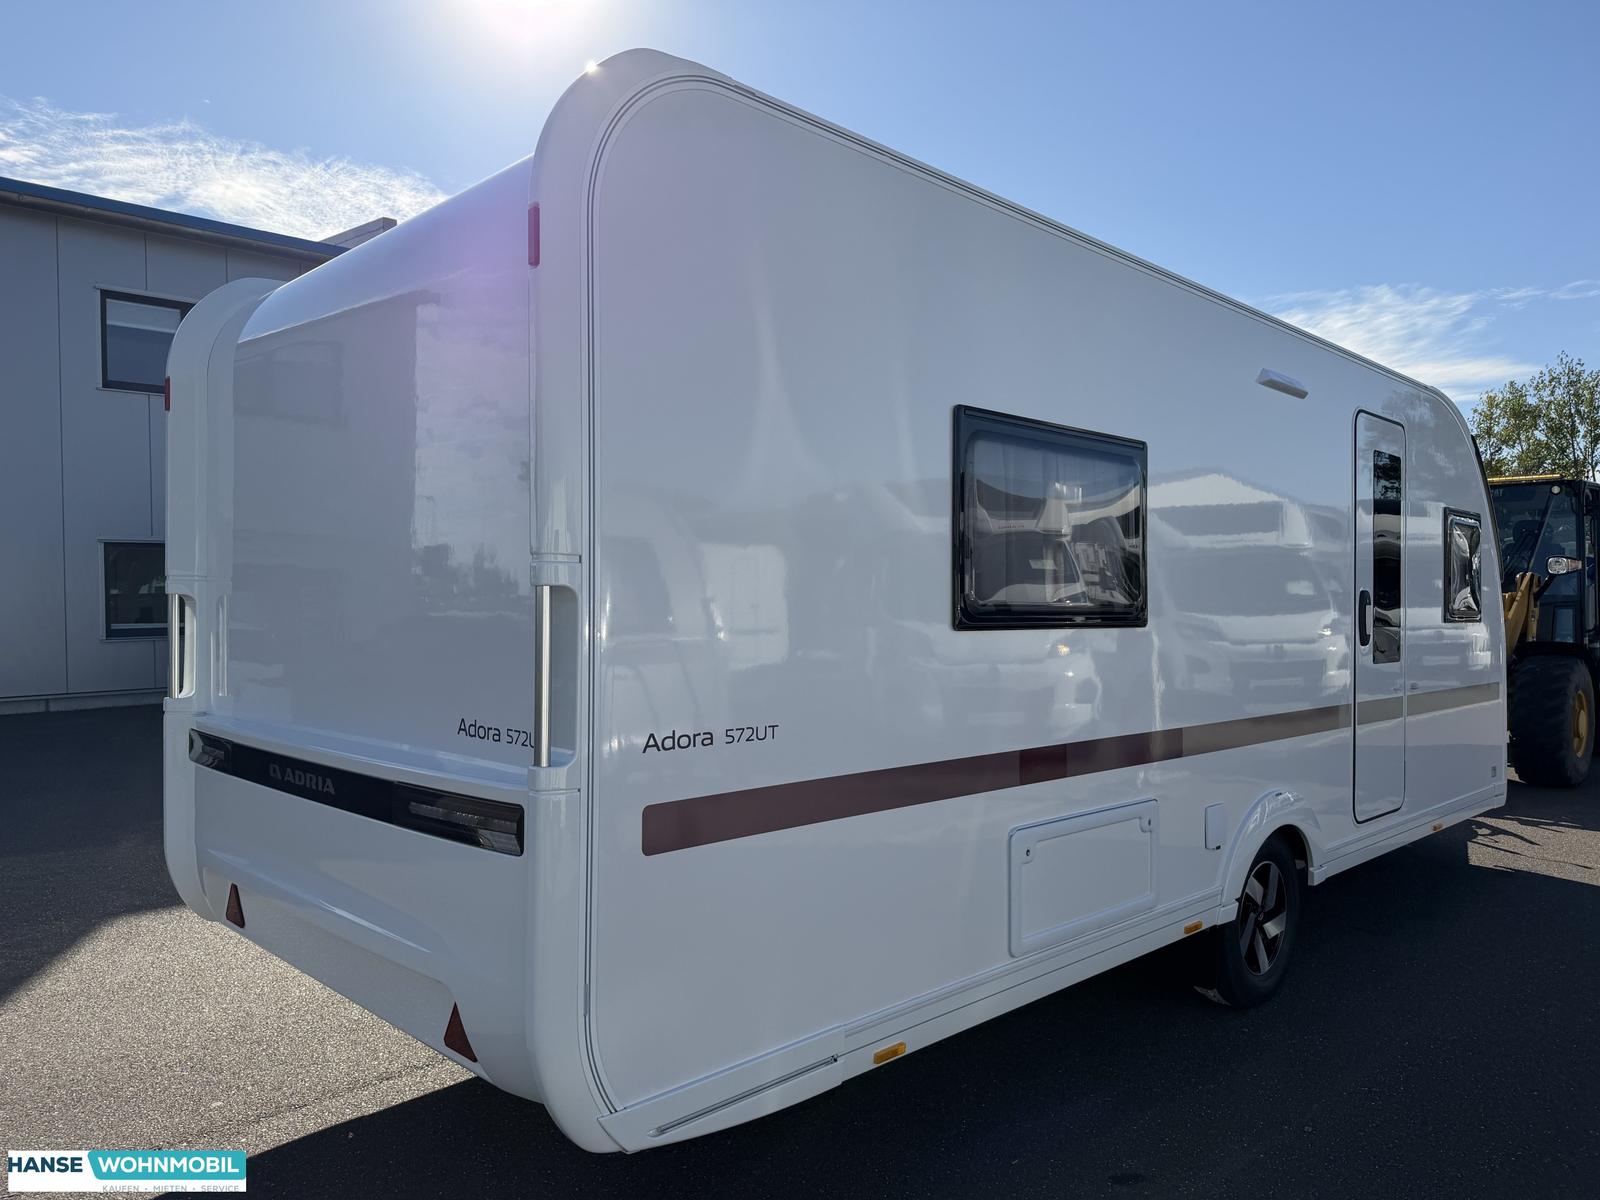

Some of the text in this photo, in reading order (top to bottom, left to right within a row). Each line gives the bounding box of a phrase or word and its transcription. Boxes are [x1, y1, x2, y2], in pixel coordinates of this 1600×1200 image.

[457, 718, 535, 749] Adora 572U
[642, 724, 779, 754] Adora 572UT
[284, 767, 335, 795] ADRIA
